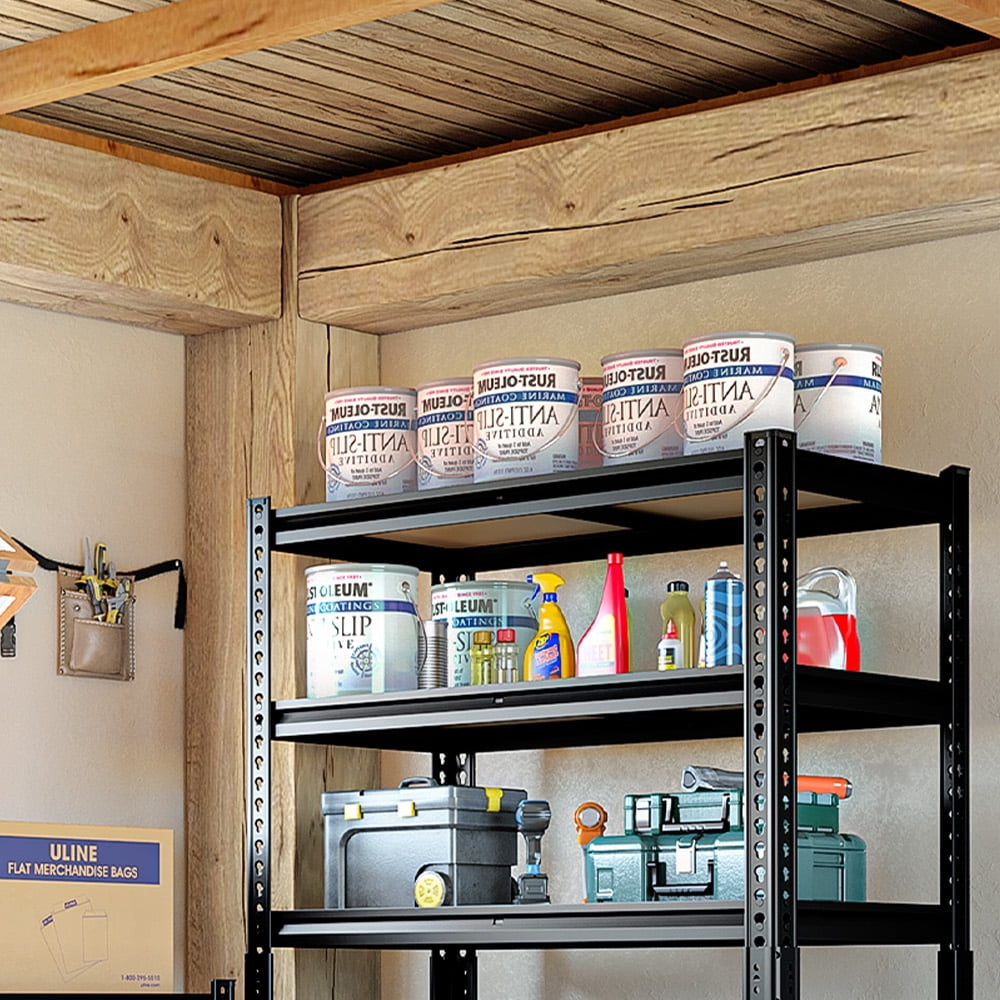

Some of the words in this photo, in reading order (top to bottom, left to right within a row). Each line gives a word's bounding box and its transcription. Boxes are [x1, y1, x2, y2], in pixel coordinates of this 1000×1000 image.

[50, 843, 98, 861] ULINE
[8, 862, 32, 875] FLAT
[34, 864, 108, 878] MERCHANDISE
[111, 866, 138, 879] BAGS
